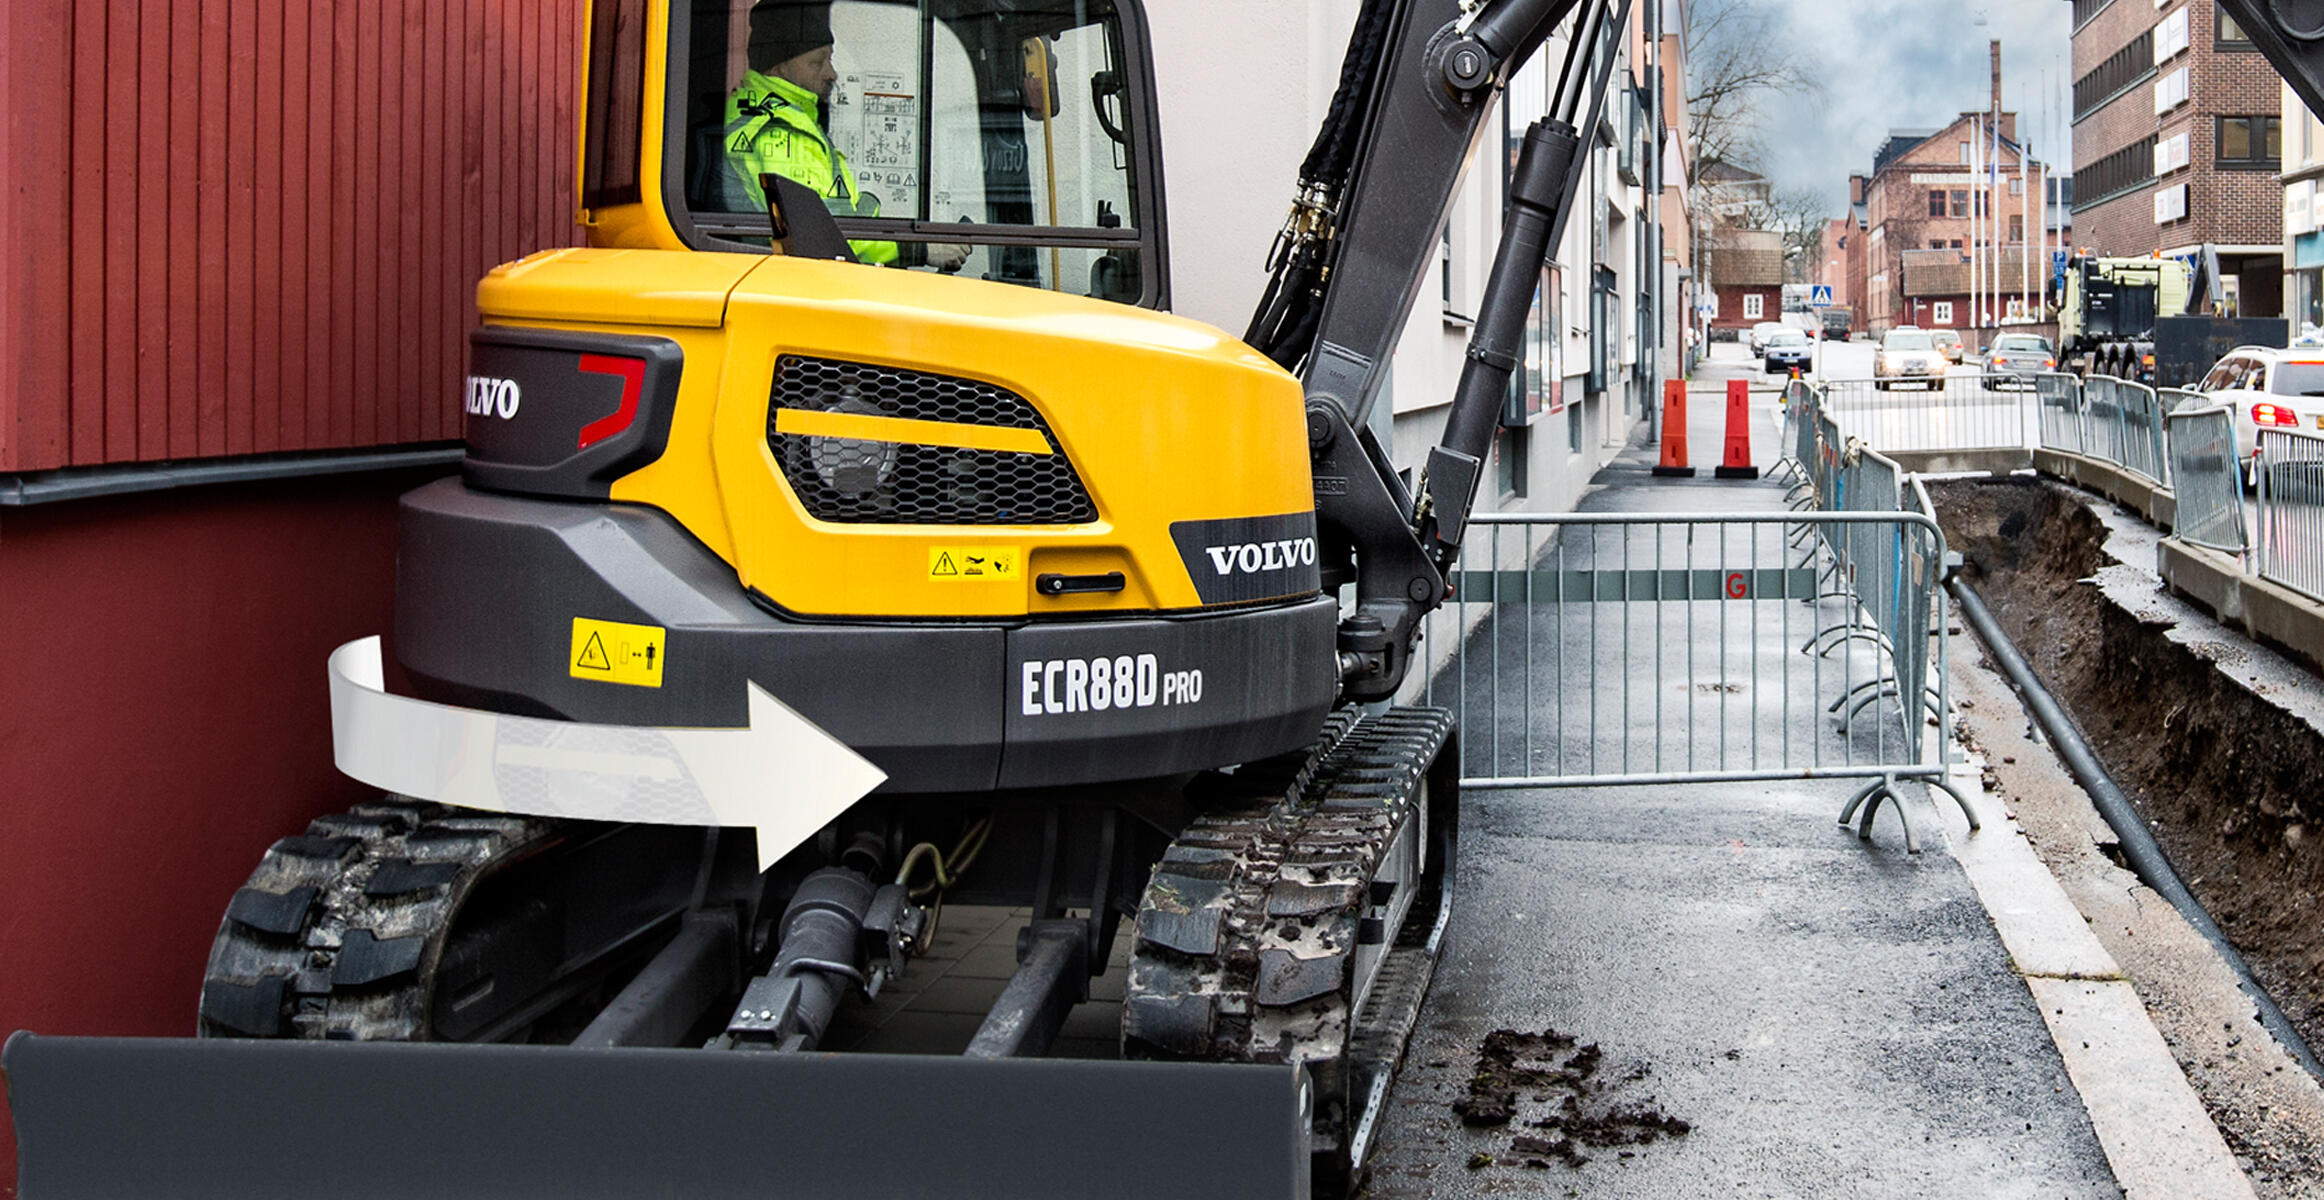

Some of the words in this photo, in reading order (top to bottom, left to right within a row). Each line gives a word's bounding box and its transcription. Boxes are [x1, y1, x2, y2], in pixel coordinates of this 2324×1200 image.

[1205, 536, 1316, 576] VOLVO
[1726, 572, 1747, 600] G
[1021, 653, 1159, 716] ECR88D
[1163, 669, 1203, 706] PRO
